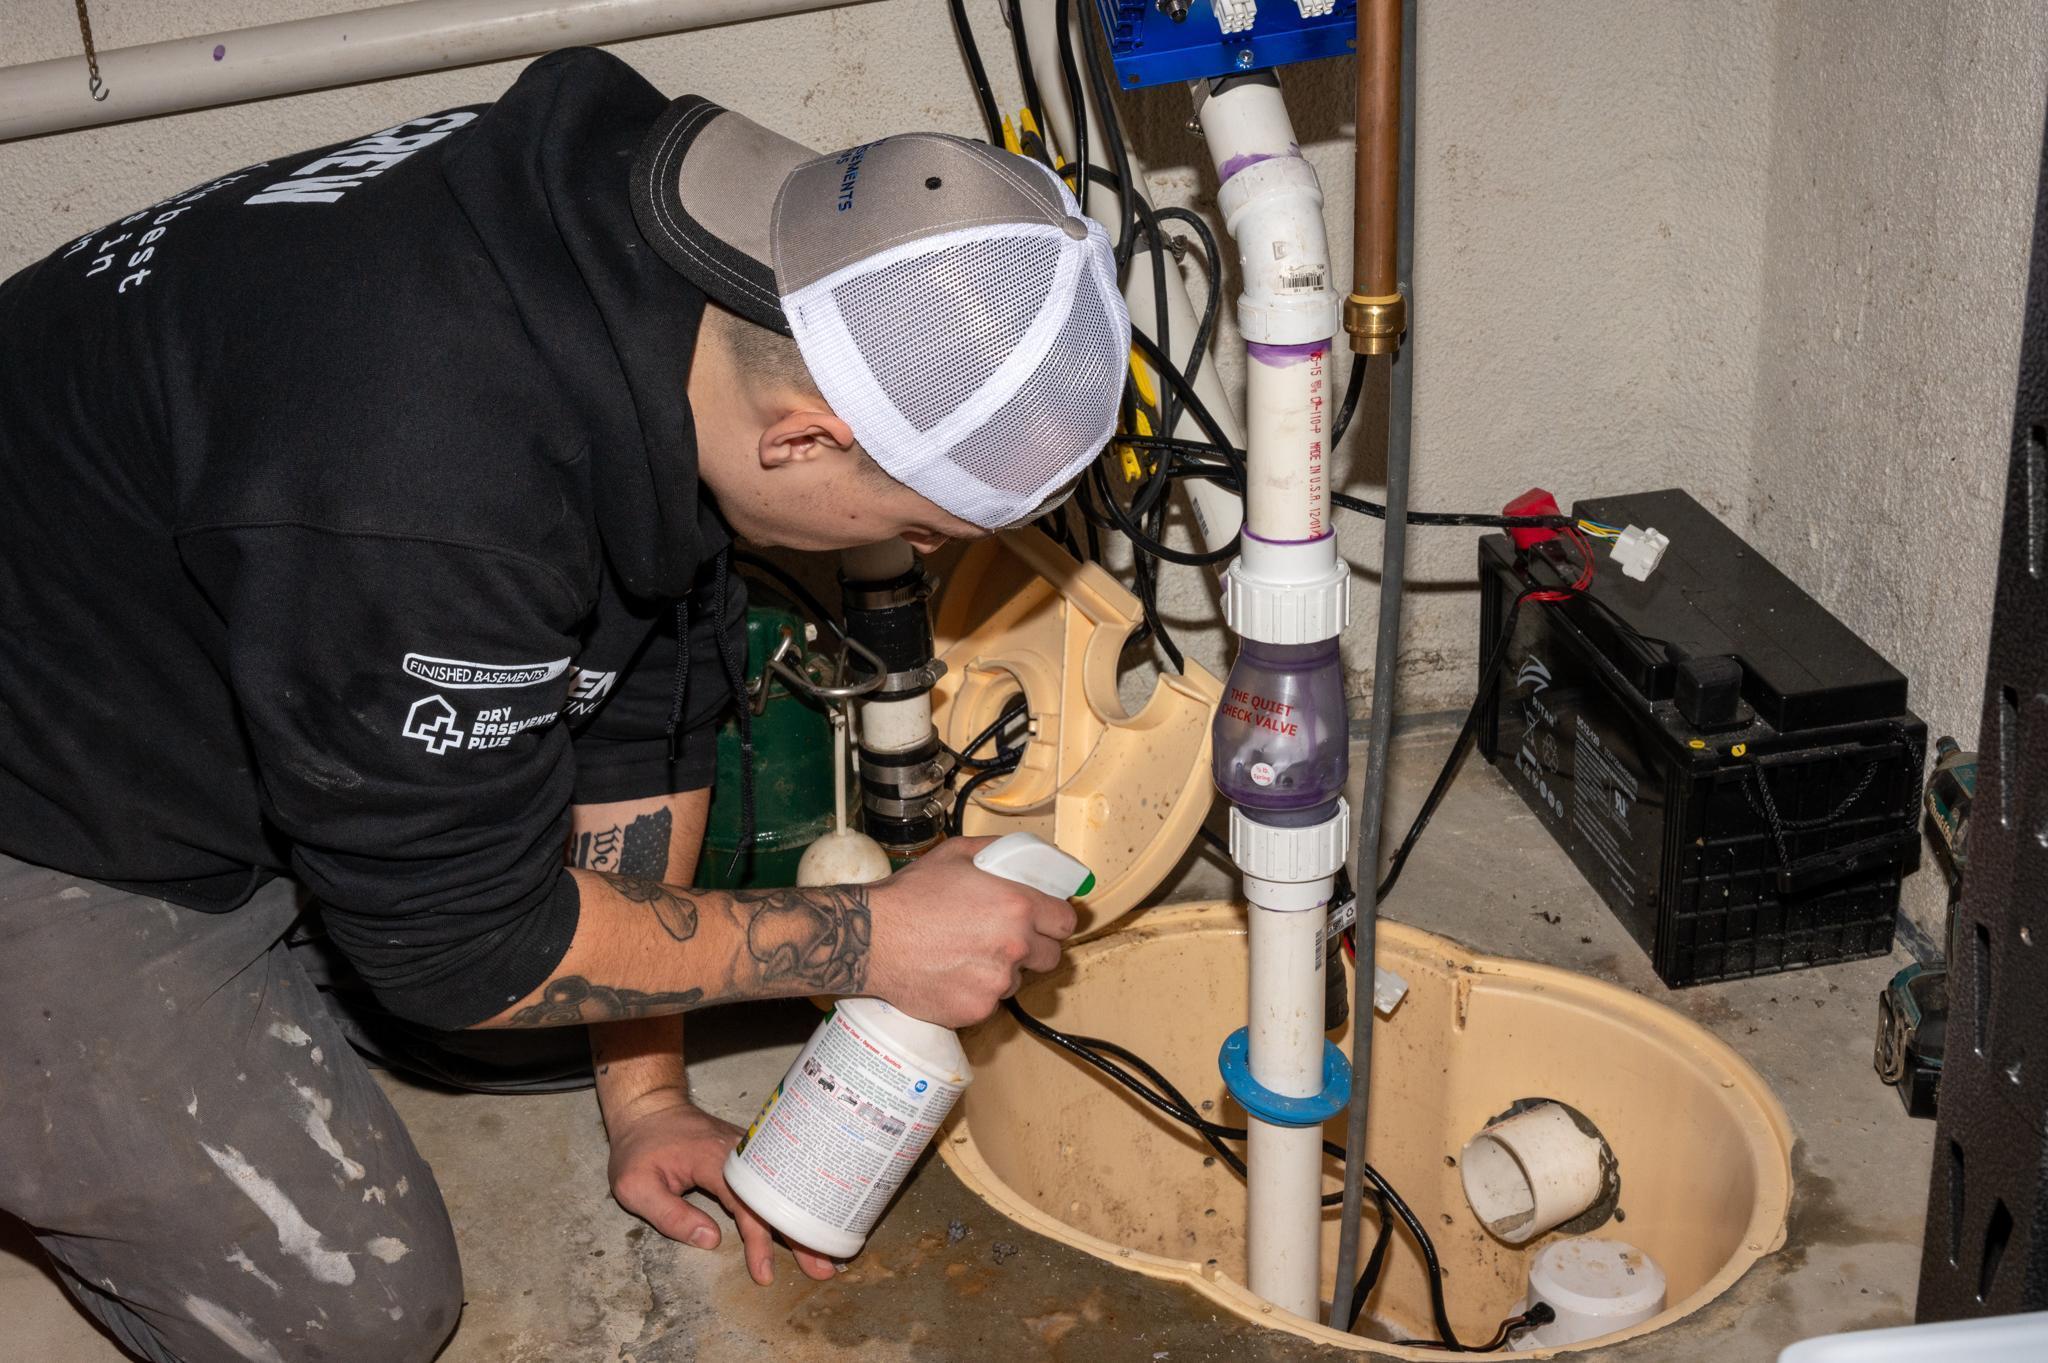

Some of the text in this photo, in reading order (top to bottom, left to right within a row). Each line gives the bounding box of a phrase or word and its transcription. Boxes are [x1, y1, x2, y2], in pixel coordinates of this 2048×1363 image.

[244, 112, 478, 205] CREW
[86, 232, 133, 277] in
[118, 206, 191, 294] best
[1310, 441, 1321, 460] MADE
[1310, 465, 1321, 474] IN
[410, 660, 545, 684] FINISHED BASEMENTS
[476, 706, 512, 722] DRY
[1231, 688, 1294, 717] THE QUIET
[472, 711, 559, 736] BASEMENTS
[1222, 702, 1298, 737] CHECK VALVE
[467, 736, 511, 750] PLUS
